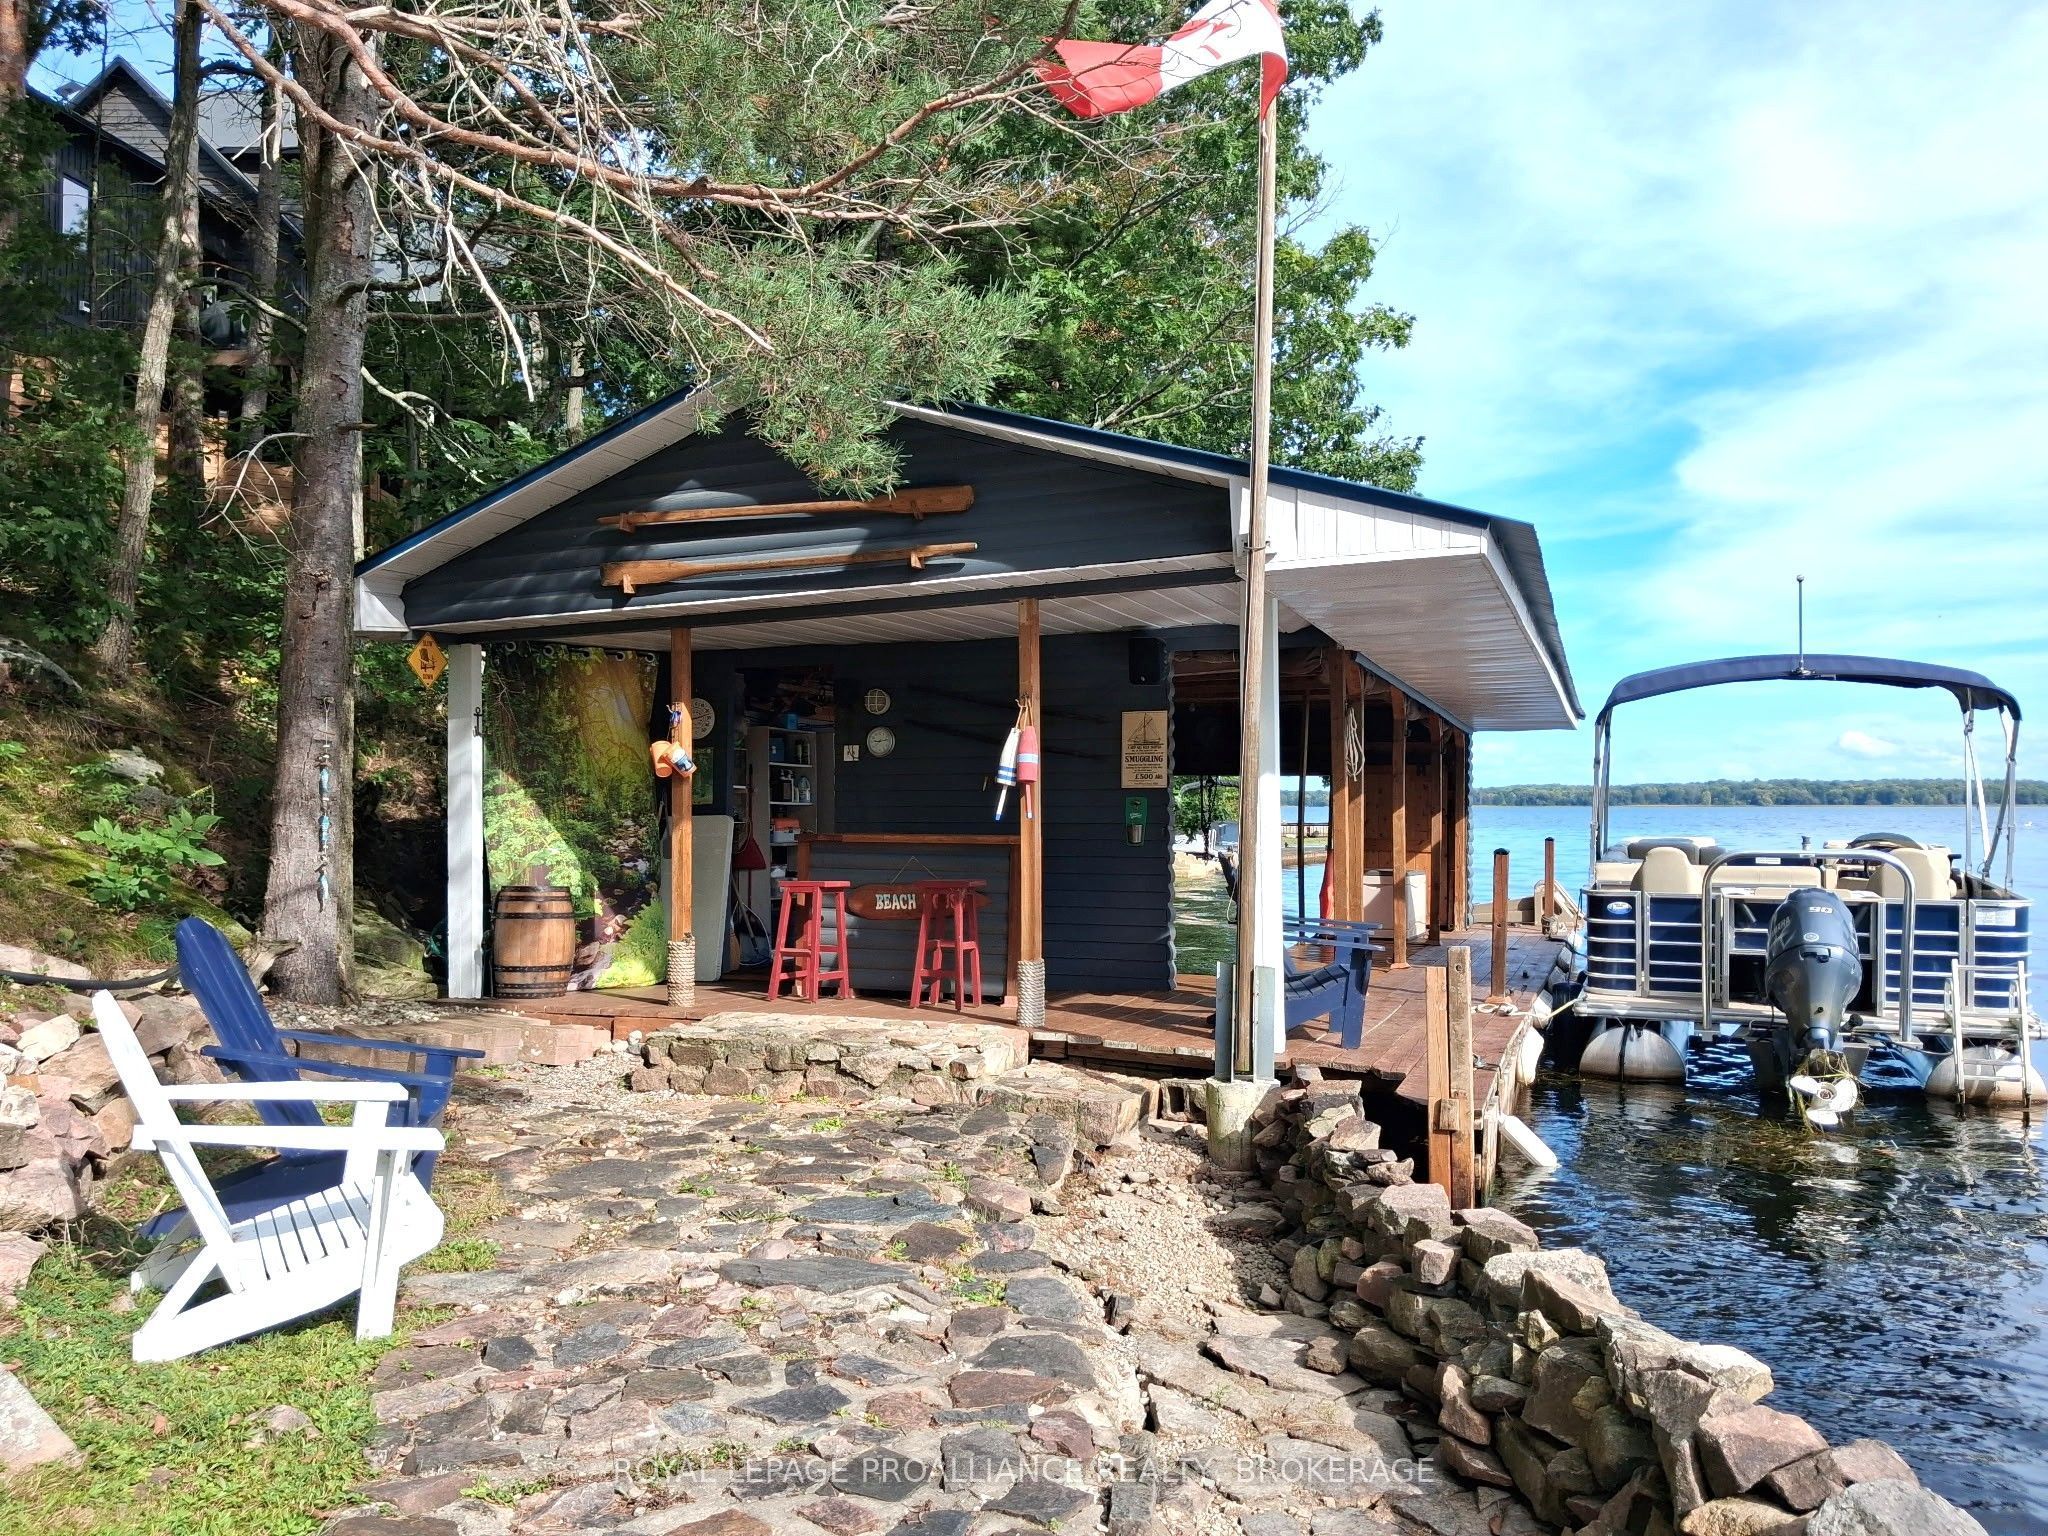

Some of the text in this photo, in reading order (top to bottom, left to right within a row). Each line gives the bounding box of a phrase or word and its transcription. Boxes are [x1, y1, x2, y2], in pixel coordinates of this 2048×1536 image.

[1125, 755, 1163, 763] SMUGGLING
[875, 893, 917, 910] BEACH
[1808, 906, 1833, 914] 90
